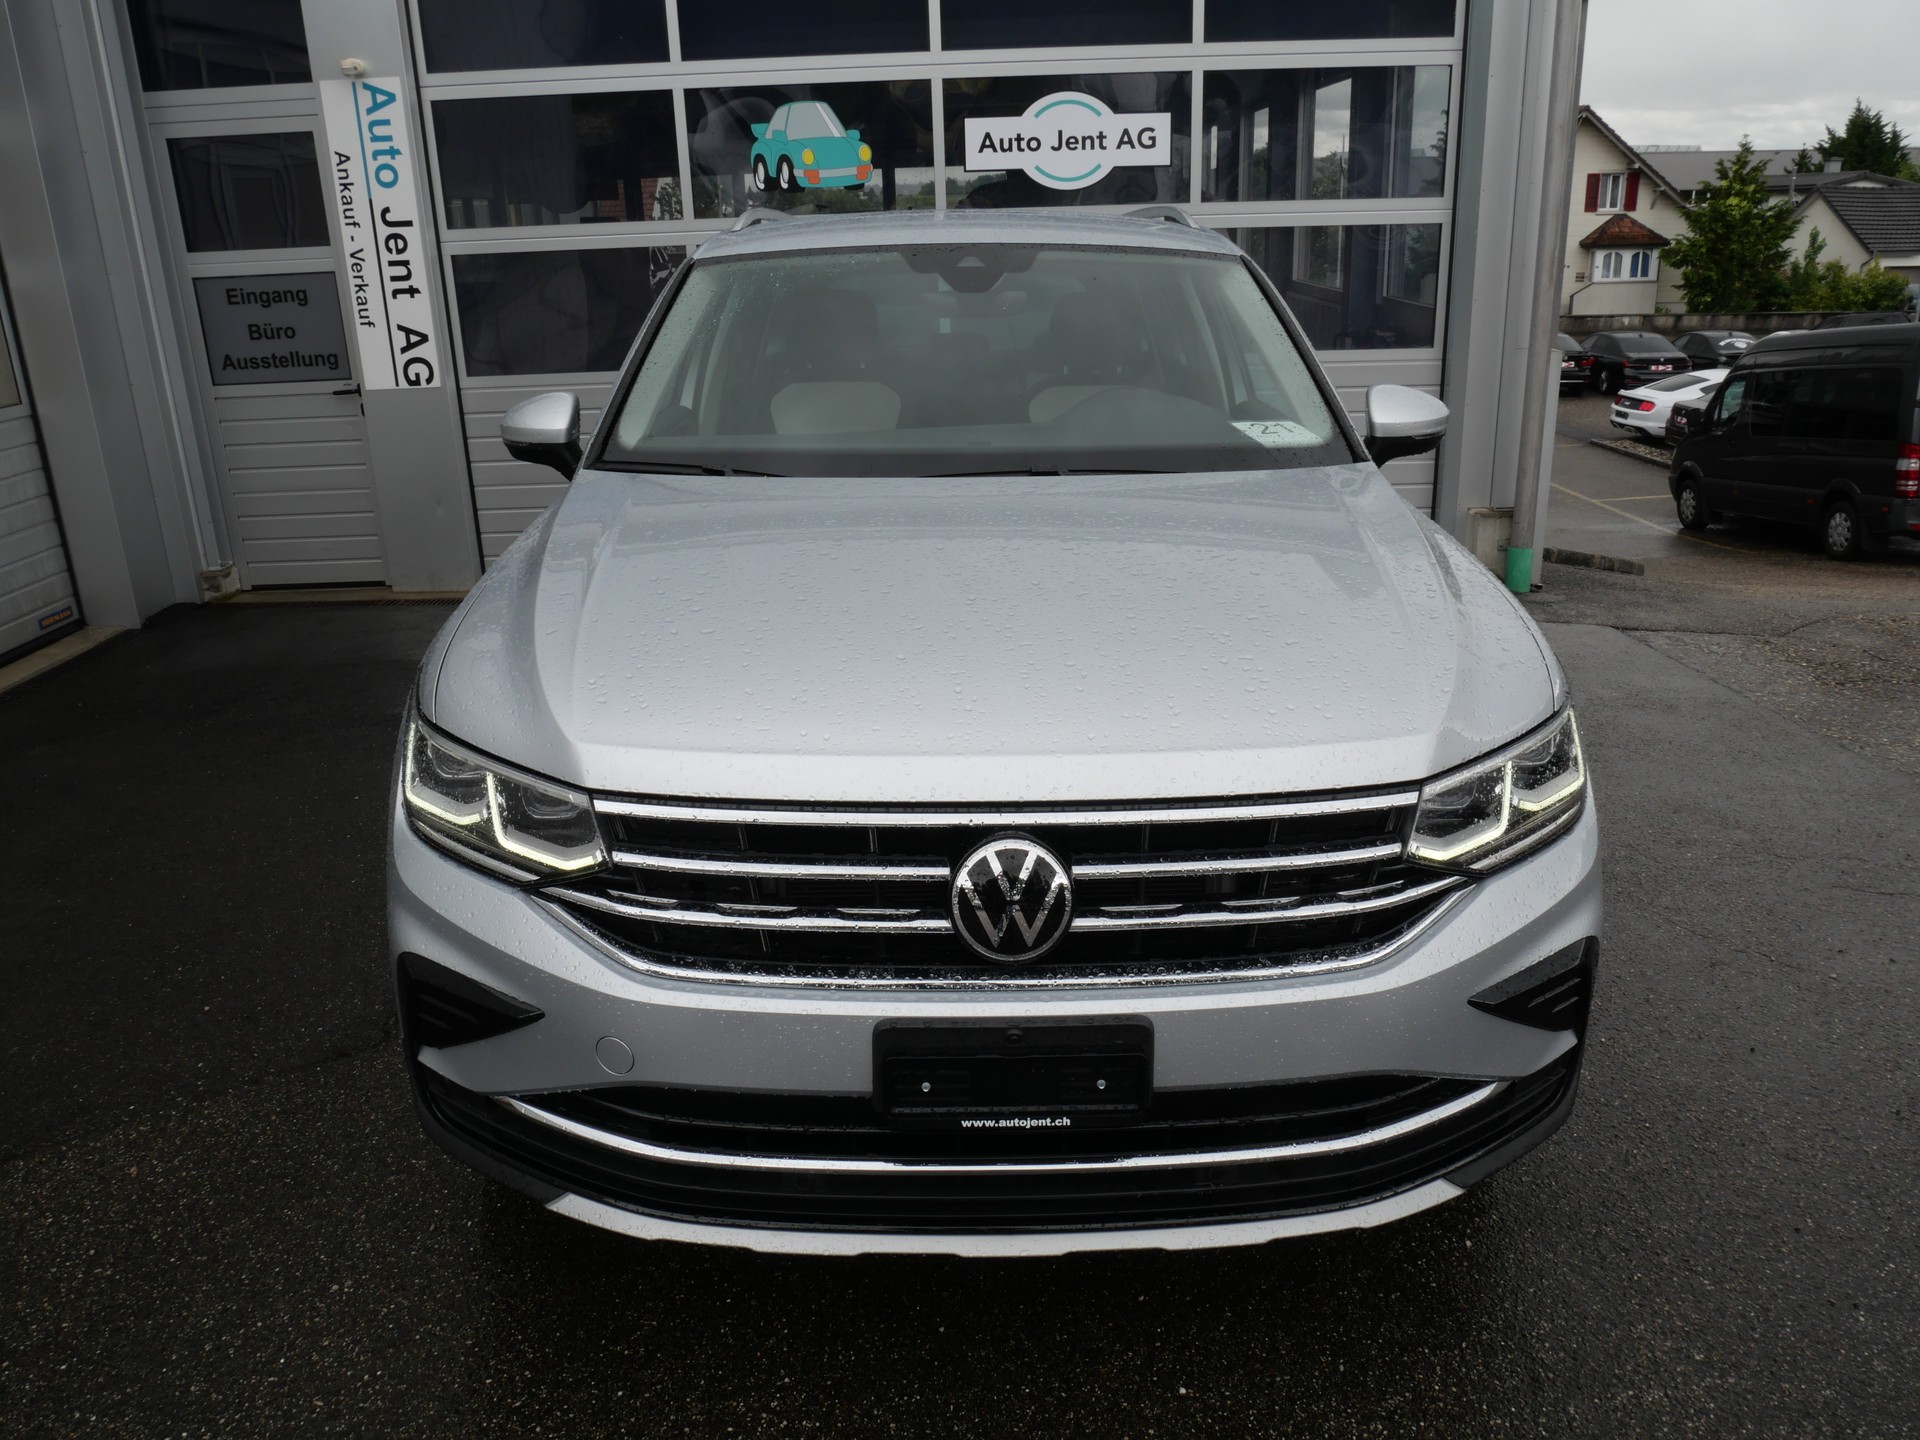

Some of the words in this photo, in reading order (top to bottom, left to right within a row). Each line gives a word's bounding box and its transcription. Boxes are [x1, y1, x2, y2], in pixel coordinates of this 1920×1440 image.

[362, 81, 403, 189] Auto
[978, 131, 1042, 154] Auto
[1050, 129, 1107, 151] Jent
[1116, 127, 1157, 150] AG
[334, 150, 361, 228] Ankauf
[349, 247, 375, 328] Verkauf
[380, 206, 422, 300] Jent
[225, 286, 309, 308] Eingang
[247, 323, 296, 341] Büro
[222, 350, 339, 372] Ausstellung
[396, 322, 435, 388] AG
[961, 1116, 1071, 1129] www.autojent.ch
